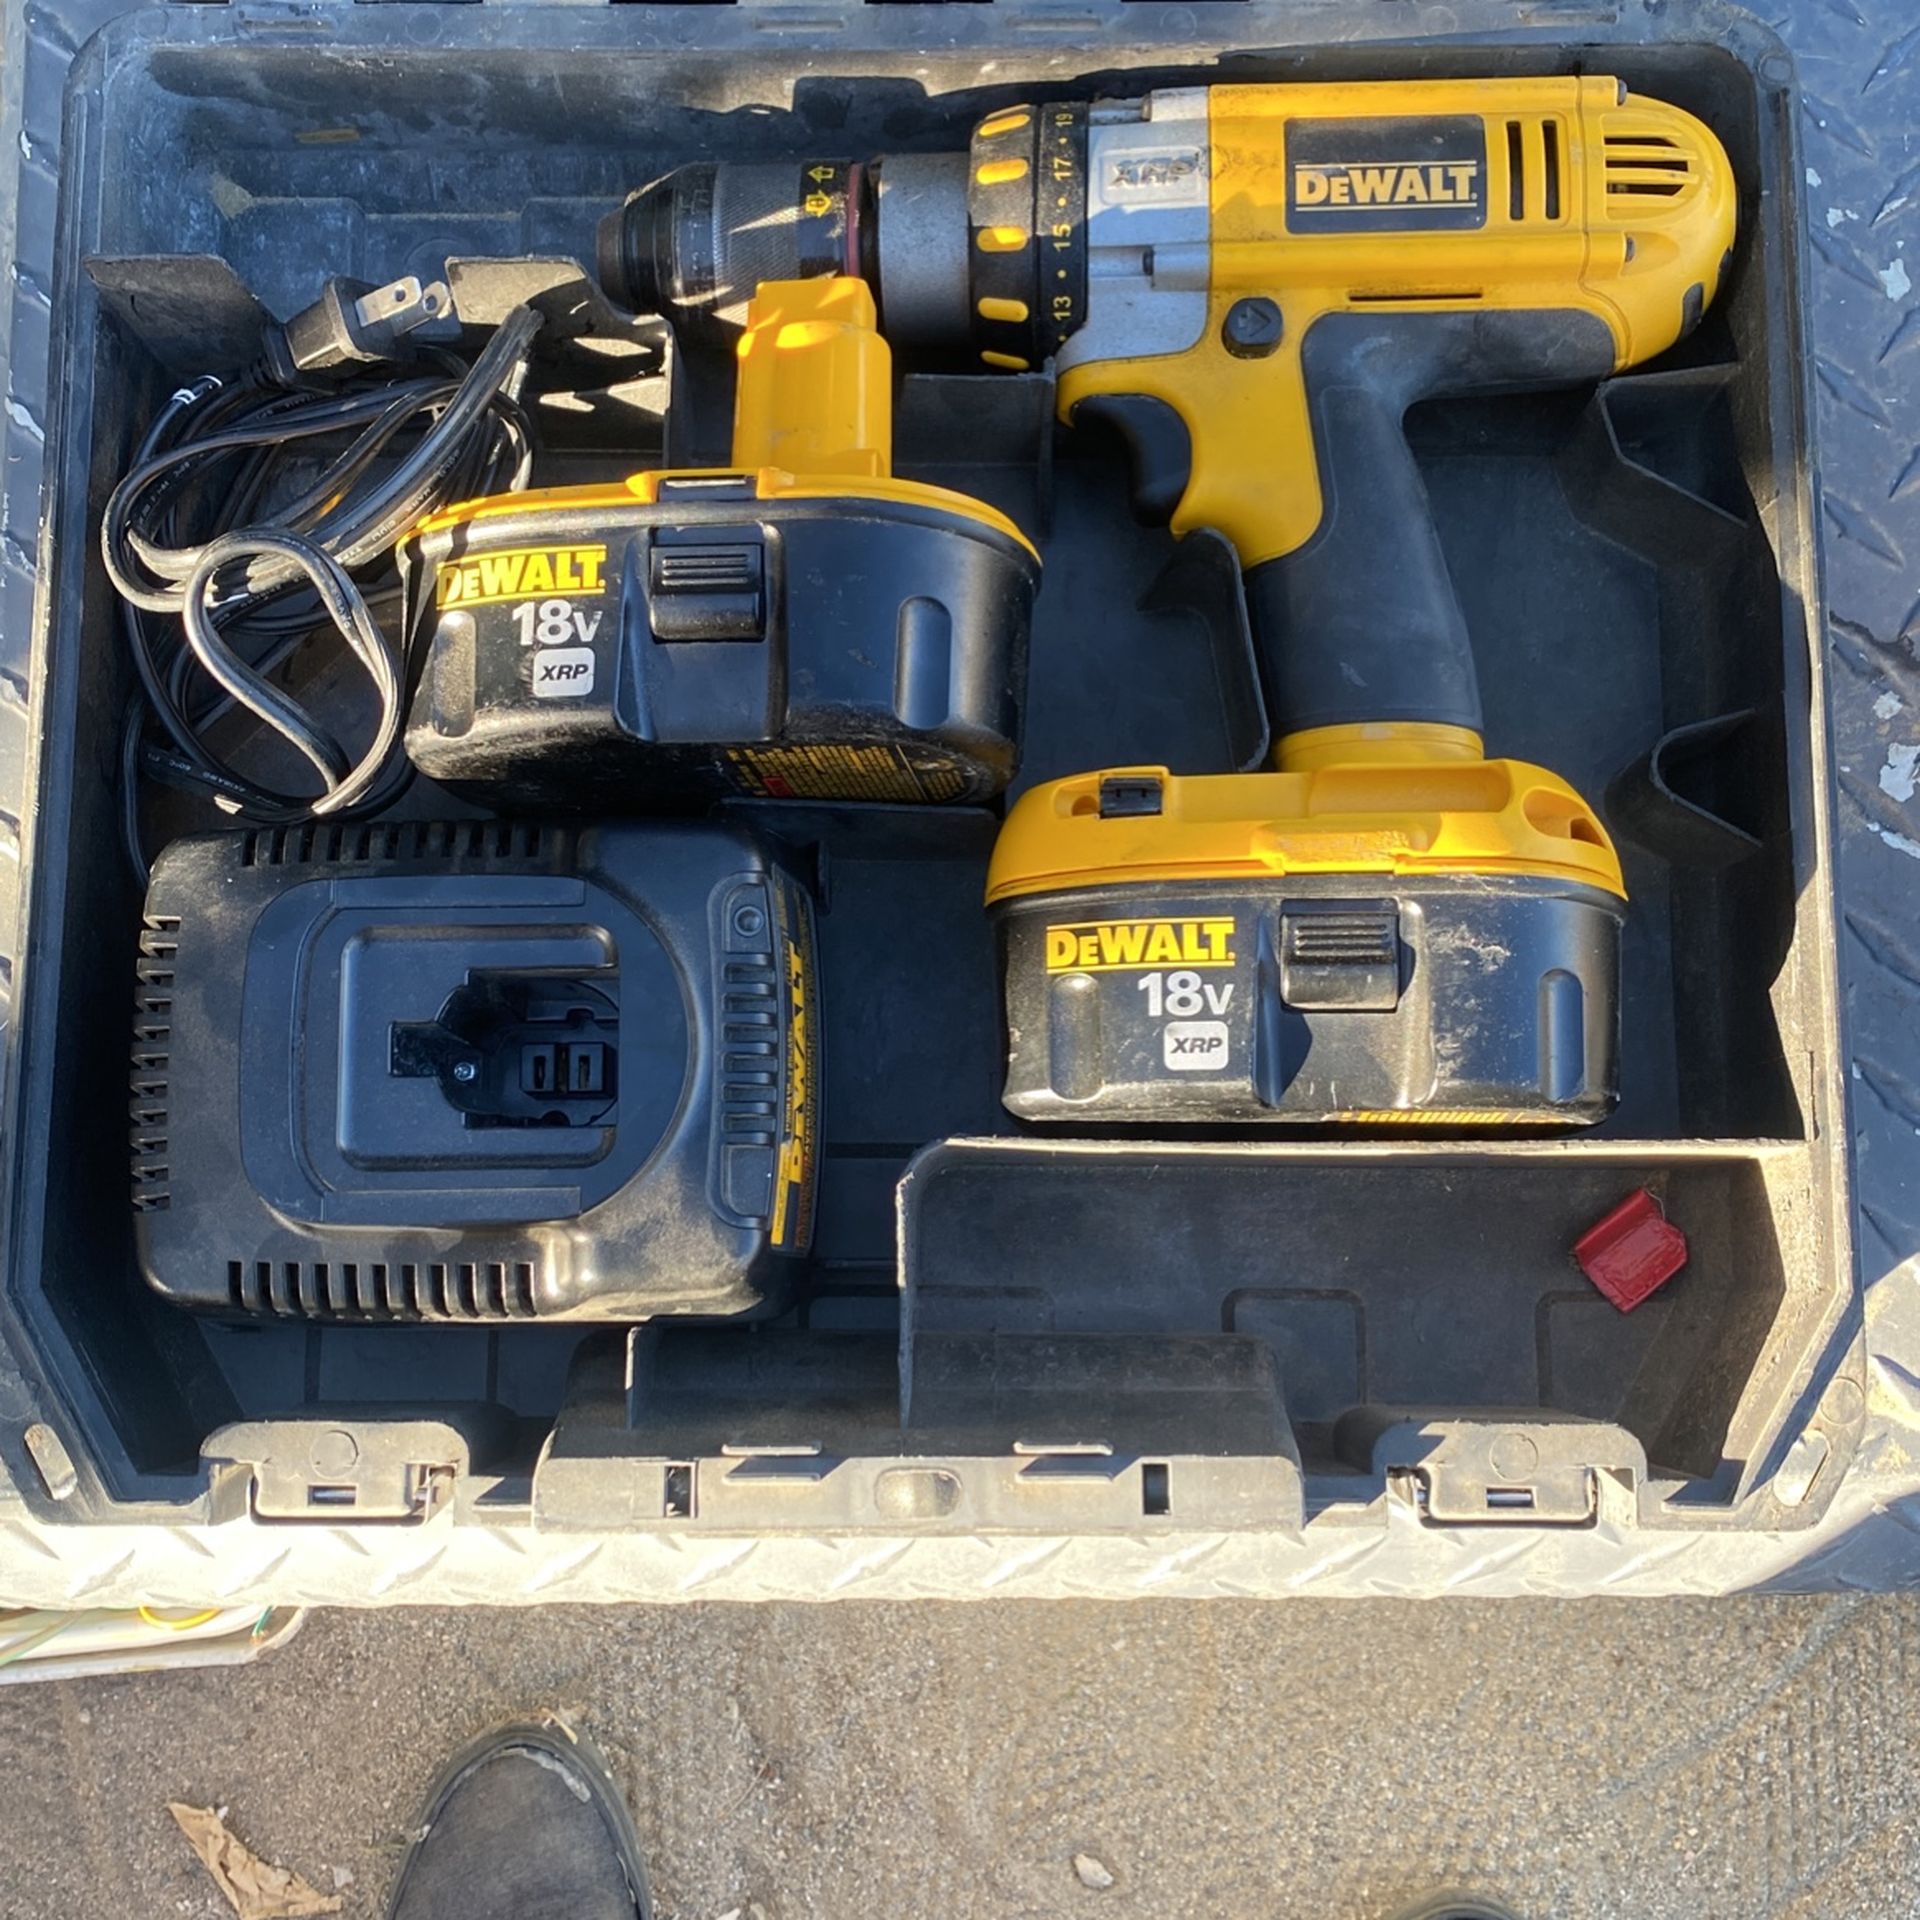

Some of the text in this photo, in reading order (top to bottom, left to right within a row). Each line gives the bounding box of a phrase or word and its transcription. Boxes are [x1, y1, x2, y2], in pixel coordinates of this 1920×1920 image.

[1053, 112, 1073, 321] 13 15 17 19
[539, 663, 589, 682] XRP
[1170, 1037, 1223, 1054] XRP
